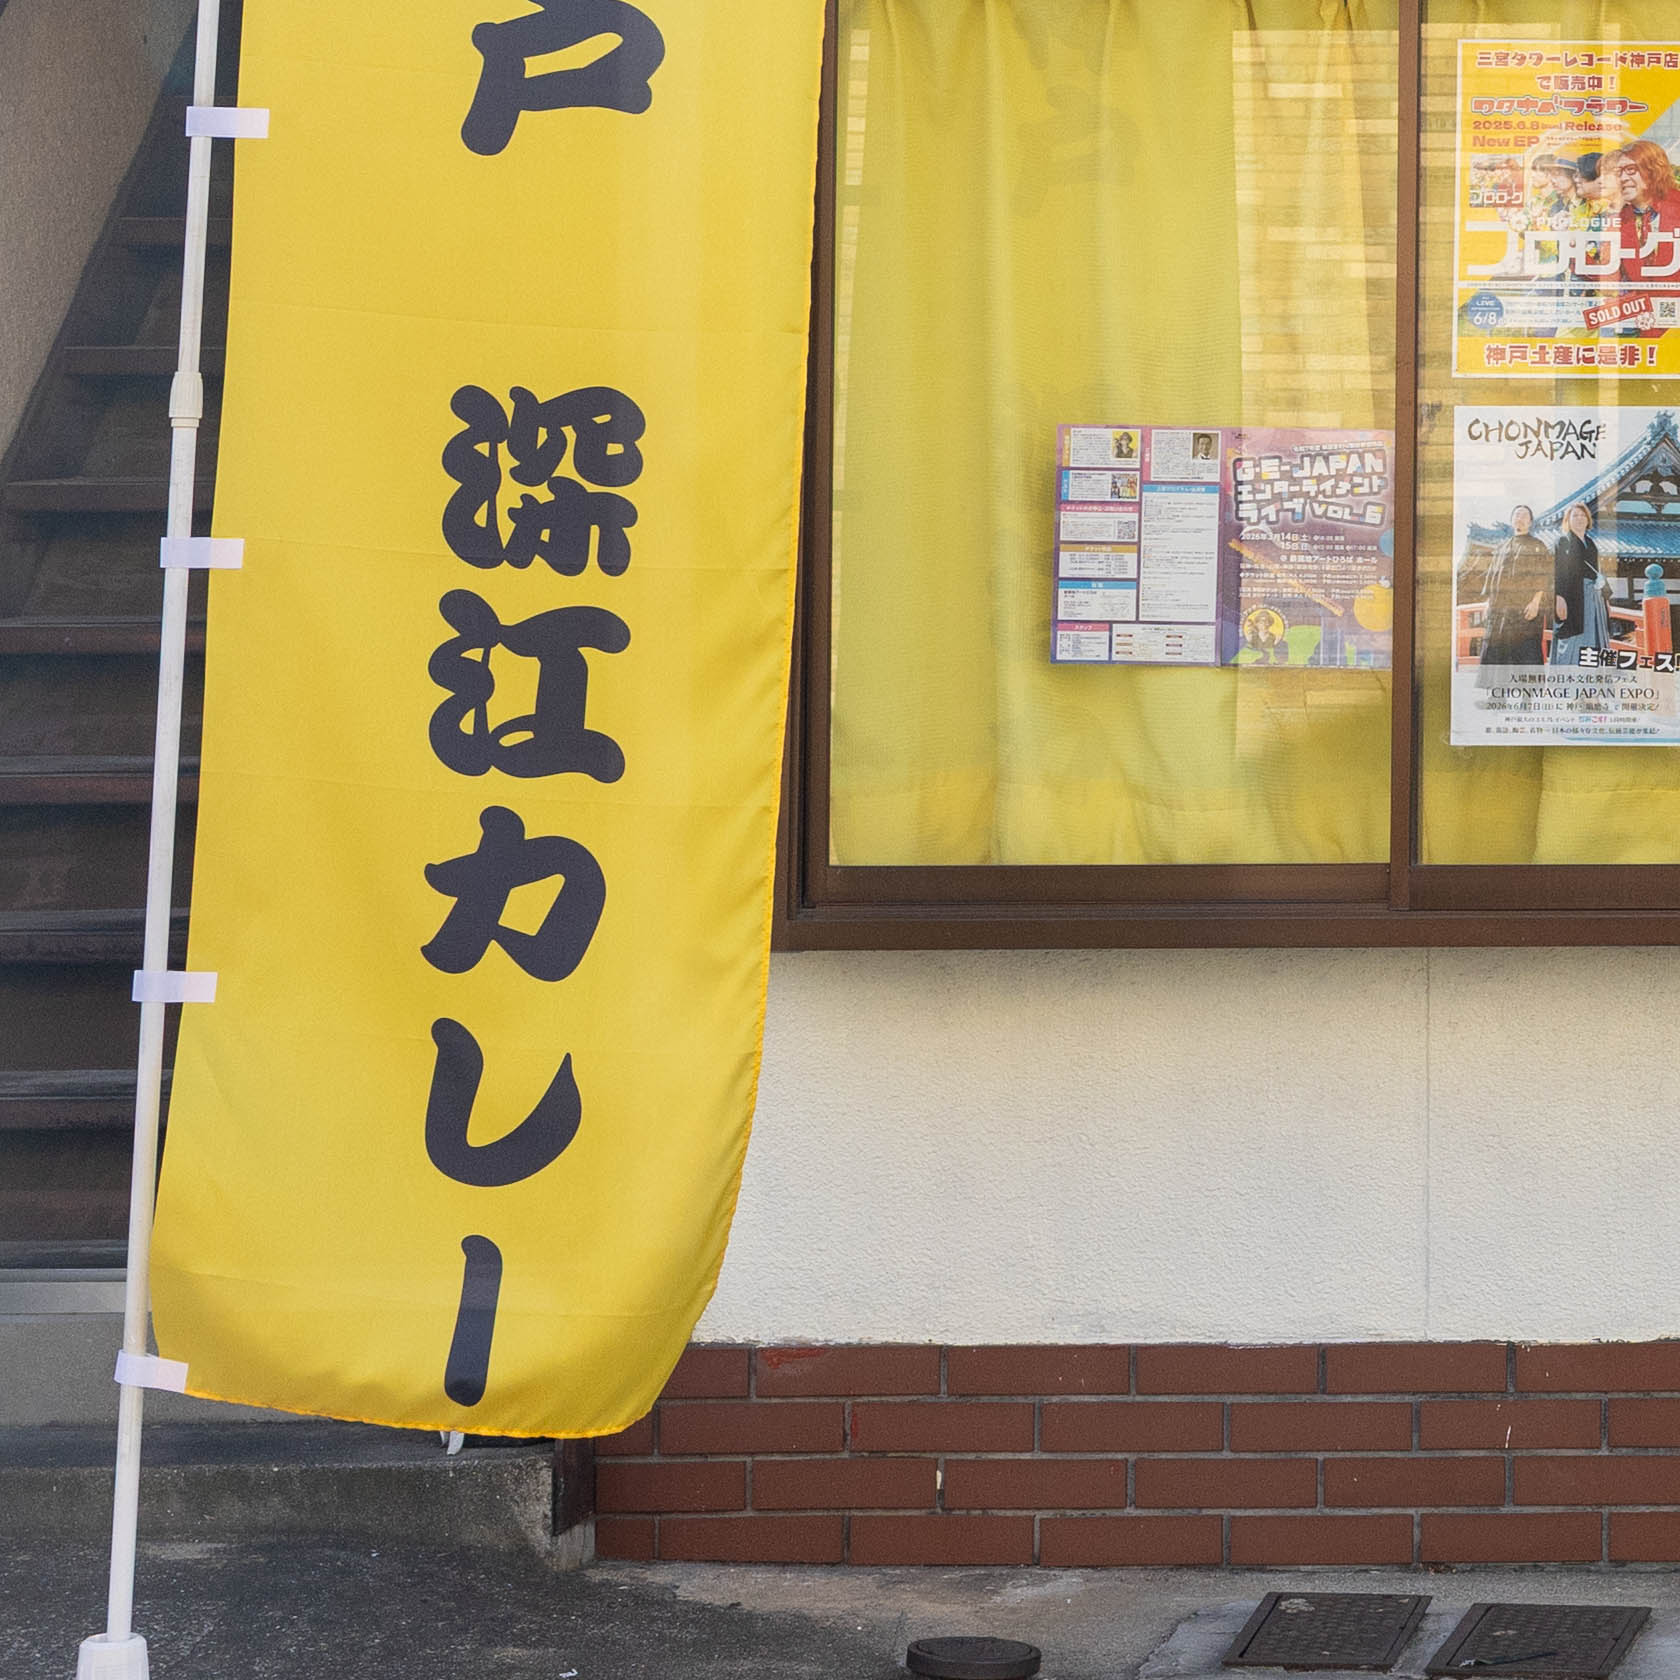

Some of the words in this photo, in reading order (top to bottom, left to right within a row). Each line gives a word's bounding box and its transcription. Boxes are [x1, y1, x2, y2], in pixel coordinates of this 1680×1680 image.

[1476, 51, 1680, 69] 三宮タワーレコード神戸店
[1473, 136, 1510, 147] New
[1514, 136, 1540, 147] EP
[1473, 313, 1496, 325] 6/8
[1589, 308, 1621, 325] SOLD
[1622, 297, 1647, 316] OUT
[1485, 345, 1659, 367] 神戸土産に是非！
[1468, 418, 1607, 442] CHONMAGE
[1516, 440, 1597, 460] JAPAN
[1575, 688, 1615, 700] JAPAN
[422, 384, 648, 1407] 深江カレー
